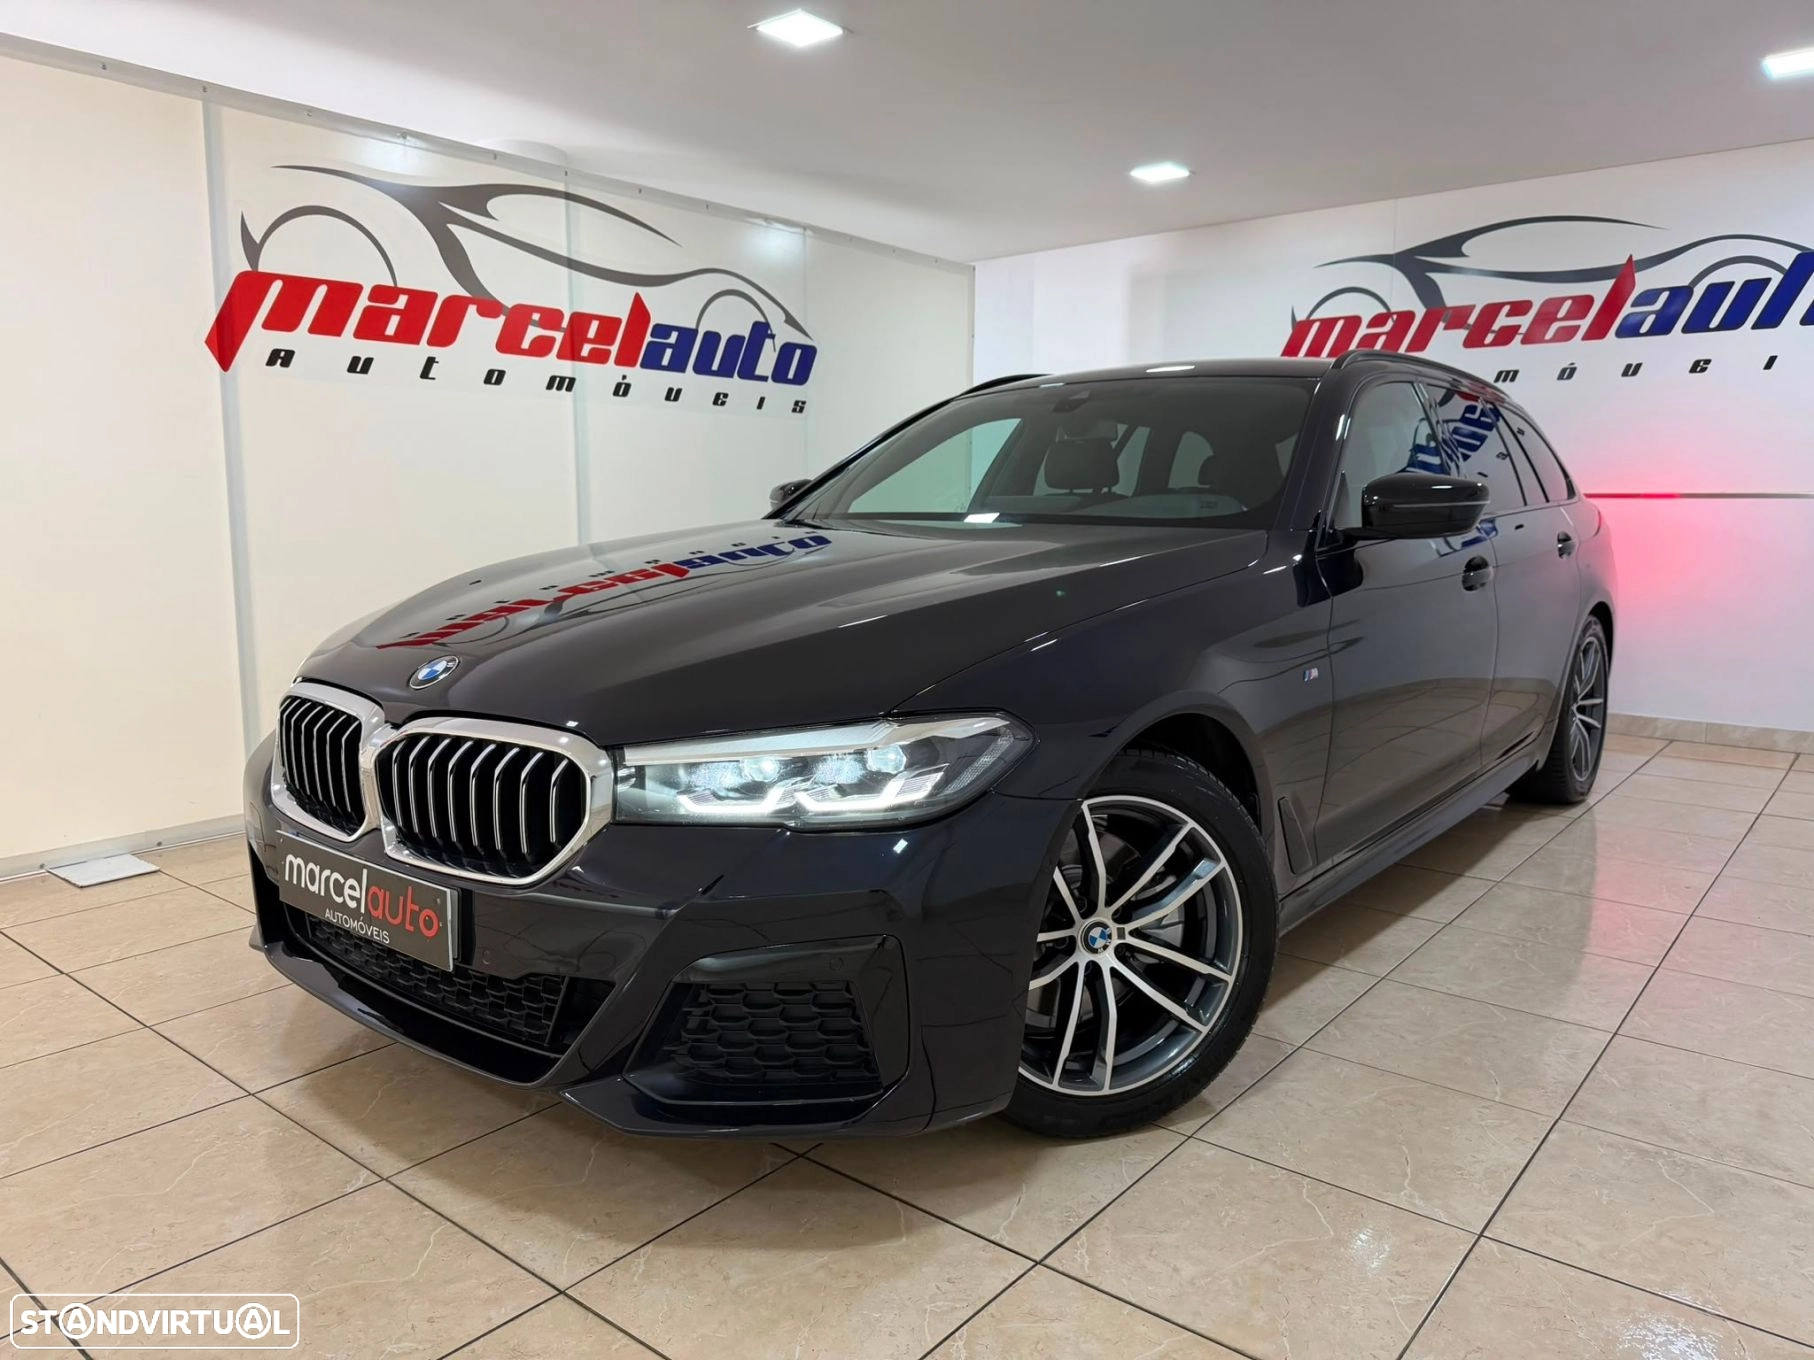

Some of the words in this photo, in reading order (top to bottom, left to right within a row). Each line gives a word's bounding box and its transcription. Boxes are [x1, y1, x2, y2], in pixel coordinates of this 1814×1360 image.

[204, 270, 817, 387] marcelauto
[1281, 252, 1814, 358] marcelaut
[284, 853, 440, 939] marcelauto
[324, 908, 390, 944] AUTOMÓVEIS
